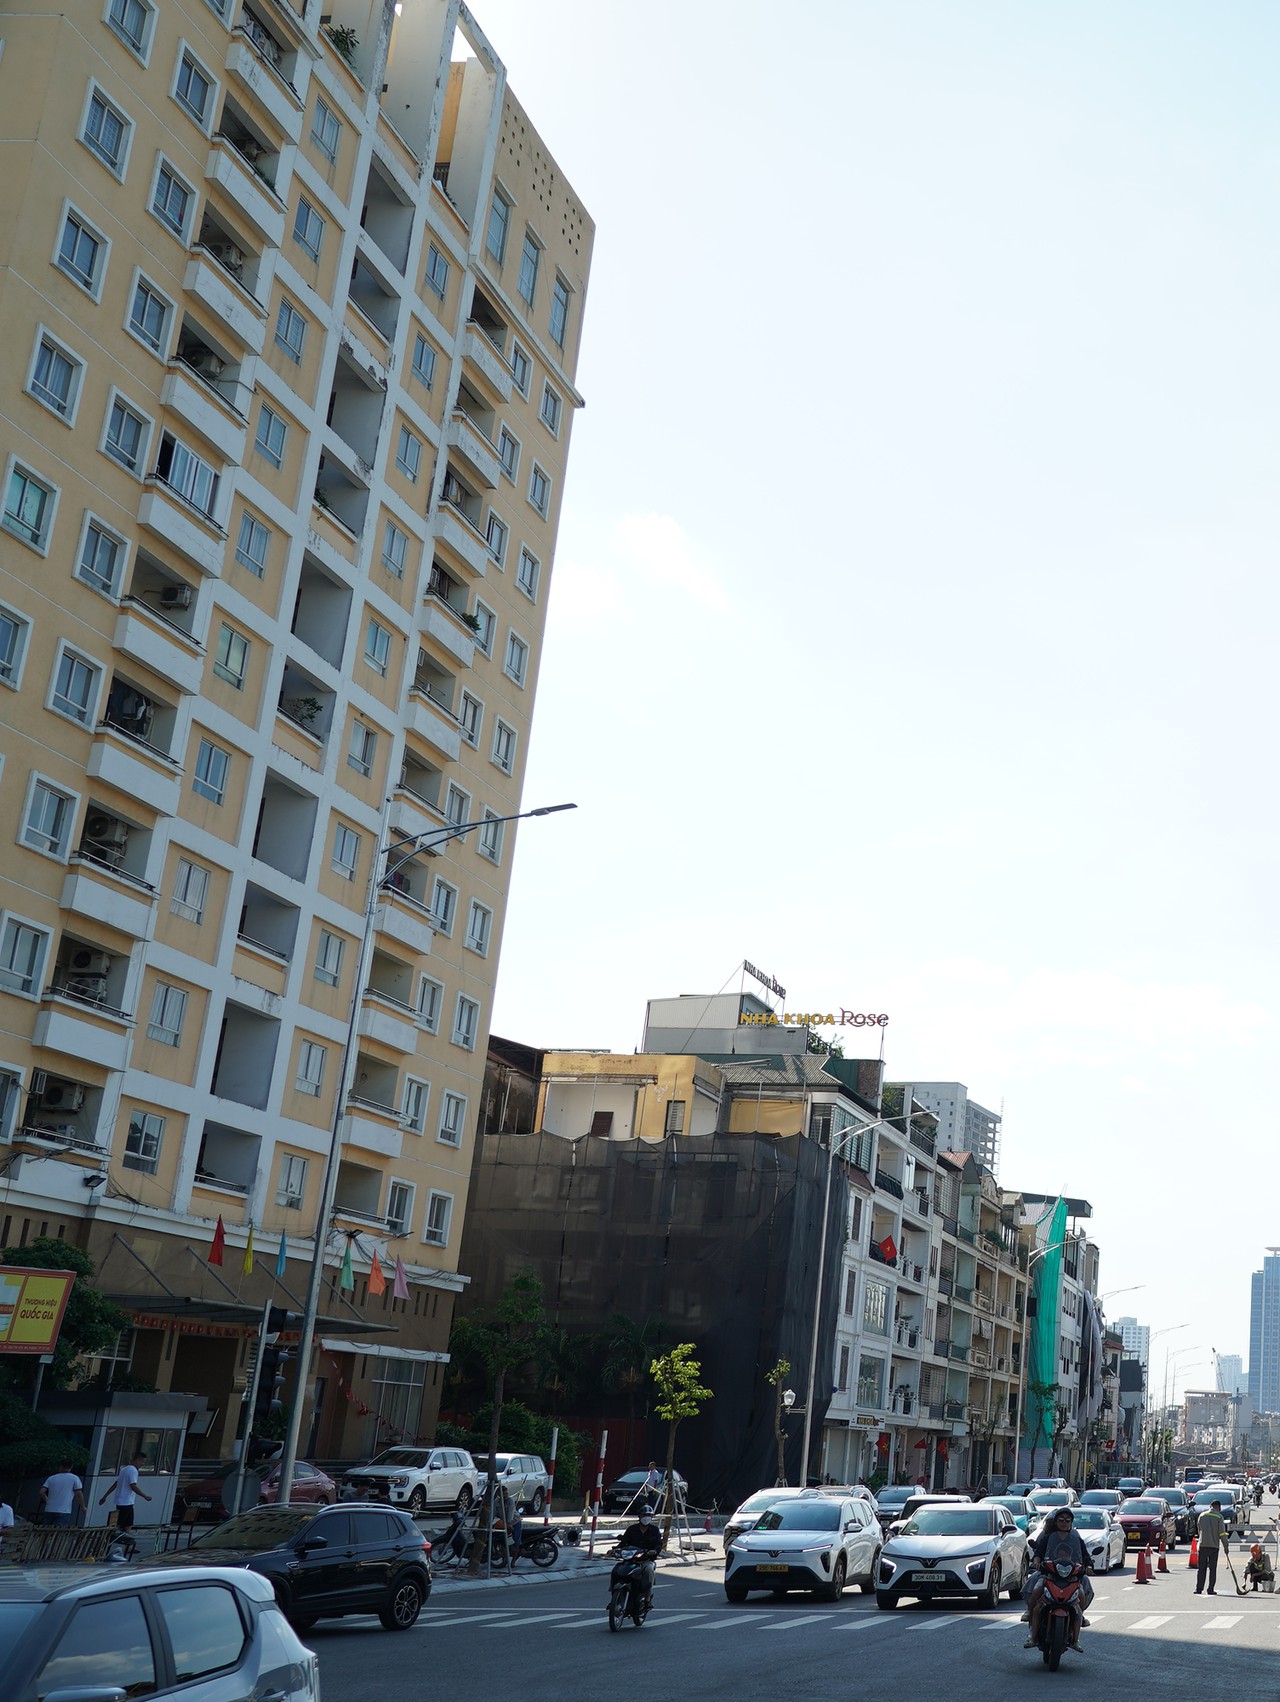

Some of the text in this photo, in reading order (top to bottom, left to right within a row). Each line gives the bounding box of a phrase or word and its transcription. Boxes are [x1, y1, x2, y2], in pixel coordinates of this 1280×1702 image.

[740, 1007, 890, 1028] NHA KHOA Rose
[20, 1306, 42, 1319] QUỐC
[42, 1311, 54, 1320] GIA
